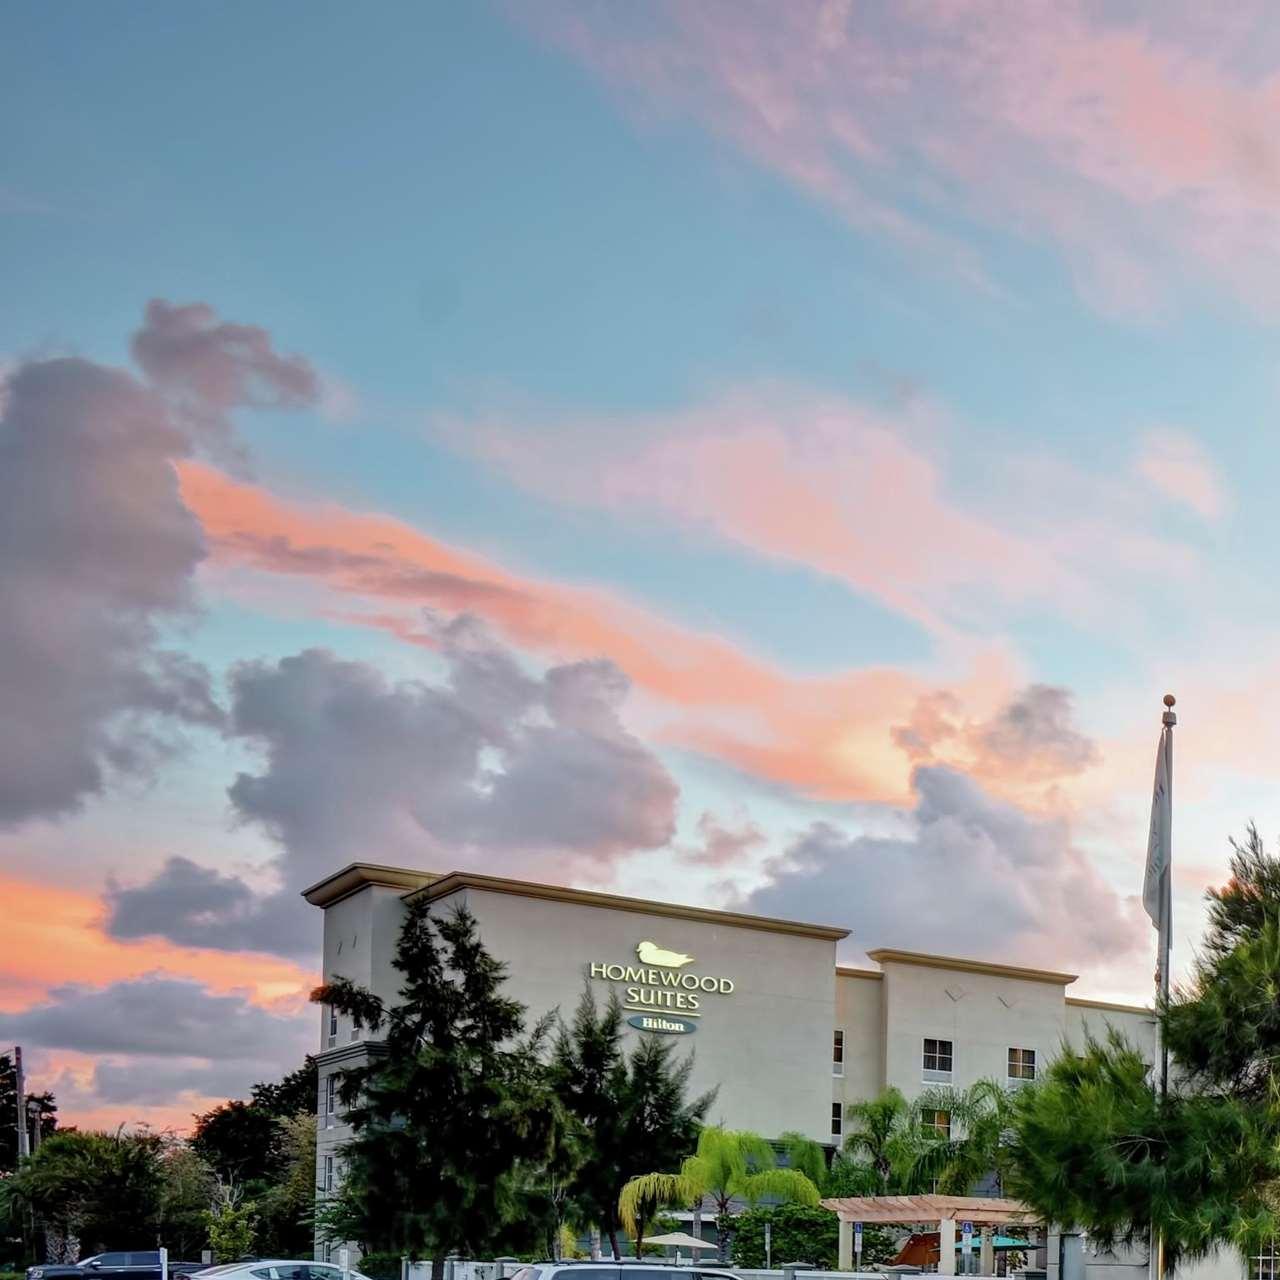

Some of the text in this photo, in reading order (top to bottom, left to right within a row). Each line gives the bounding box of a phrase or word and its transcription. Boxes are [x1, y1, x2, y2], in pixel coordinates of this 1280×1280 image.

[590, 962, 734, 994] HOMEWOOD
[626, 987, 700, 1010] SUITES
[642, 1017, 685, 1032] Hilton
